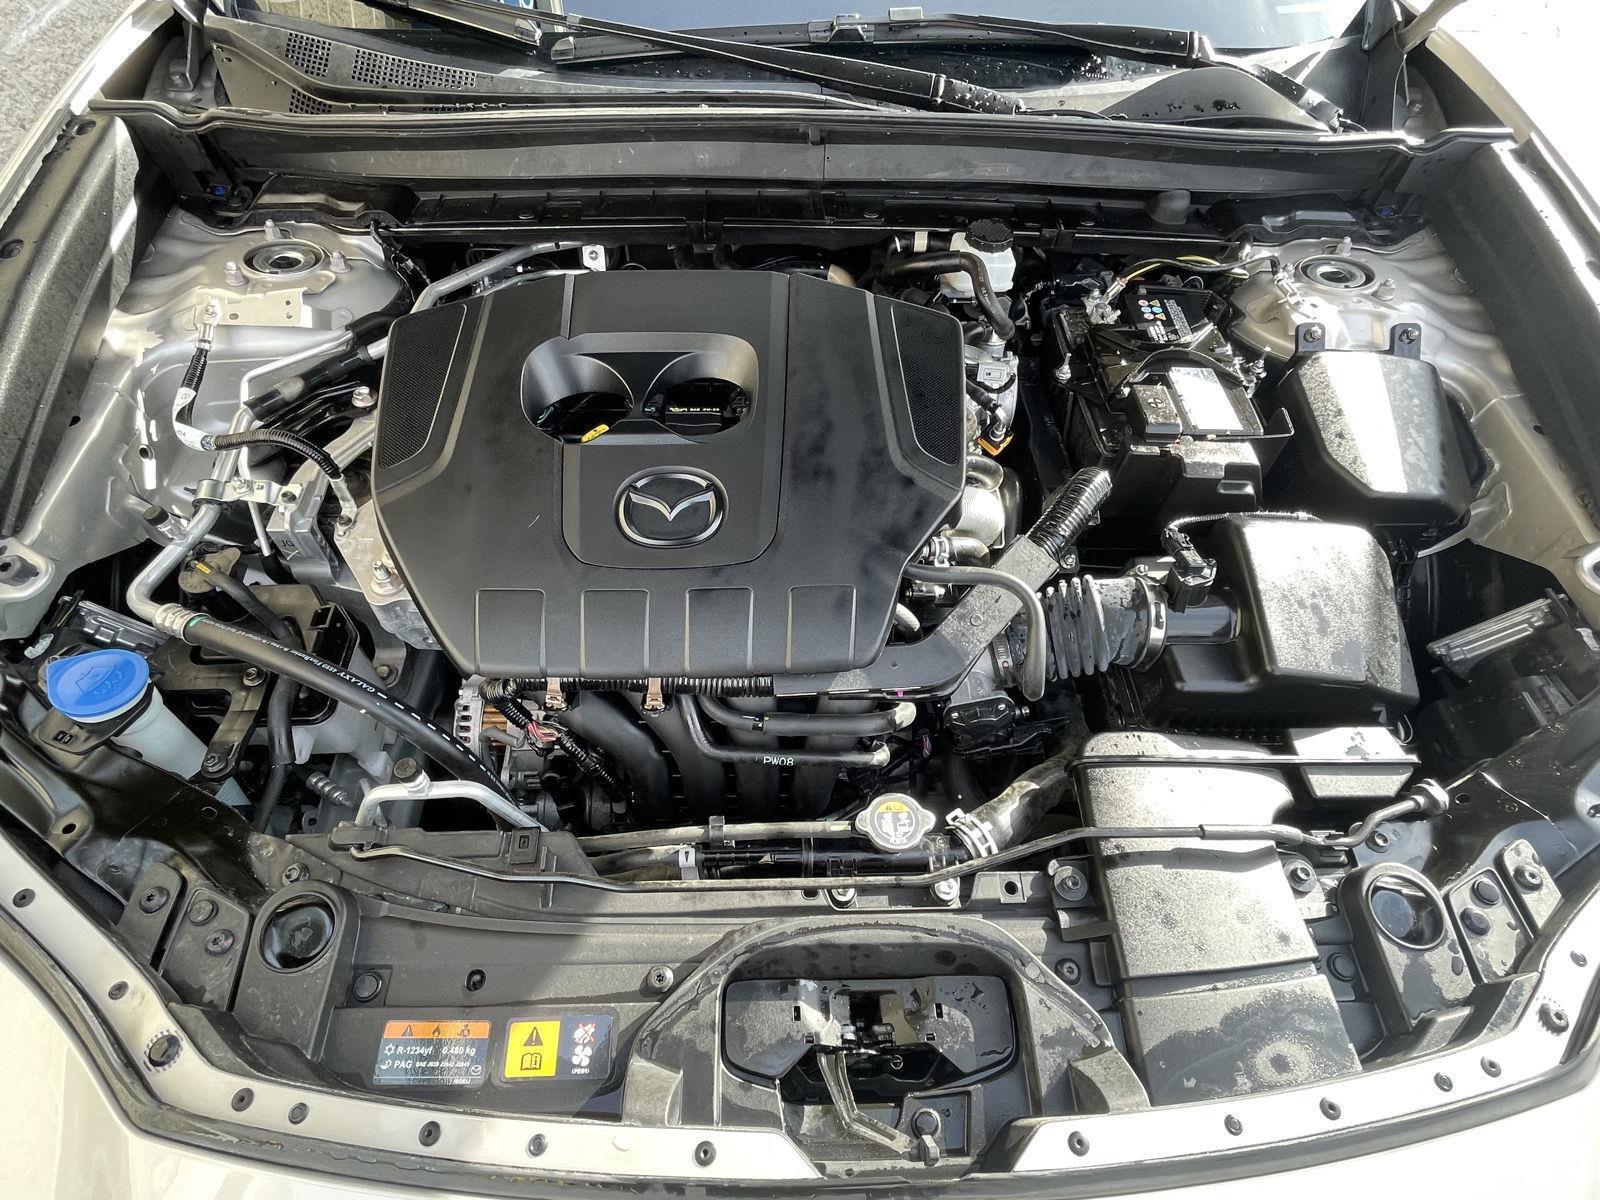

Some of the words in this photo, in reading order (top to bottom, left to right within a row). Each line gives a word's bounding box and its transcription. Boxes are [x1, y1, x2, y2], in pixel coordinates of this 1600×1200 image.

[337, 671, 376, 693] GALAXY
[763, 756, 794, 766] PW08
[396, 1046, 433, 1056] R-1234yf
[442, 1046, 464, 1055] 0.480
[465, 1045, 477, 1056] kg
[393, 1060, 413, 1069] PAG
